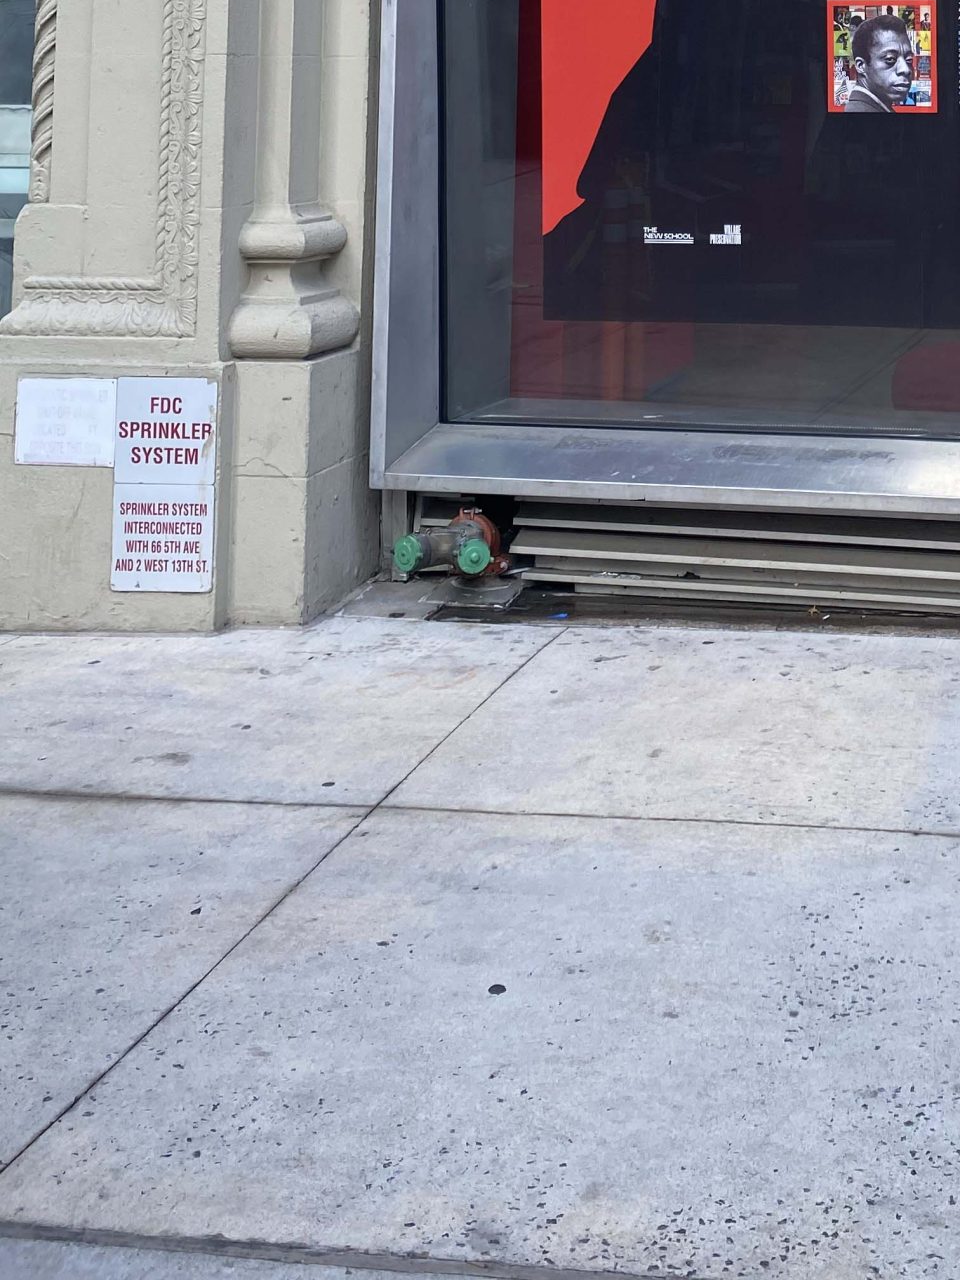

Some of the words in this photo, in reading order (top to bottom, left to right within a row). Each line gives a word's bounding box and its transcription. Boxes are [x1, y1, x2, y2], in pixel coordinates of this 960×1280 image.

[150, 397, 182, 414] FDC
[118, 421, 212, 440] SPRINKLER
[131, 447, 199, 466] SYSTEM
[119, 502, 169, 516] SPRINKLER
[172, 504, 208, 517] SYSTEM
[124, 522, 202, 536] INTERCONNECTED
[126, 540, 149, 554] WITH
[151, 540, 162, 554] 66
[164, 540, 181, 554] 5TH
[183, 540, 200, 554] AVE
[115, 559, 134, 572] AND
[136, 559, 141, 572] 2
[144, 560, 169, 572] WEST
[172, 560, 194, 572] 13TH
[196, 560, 209, 573] ST.
